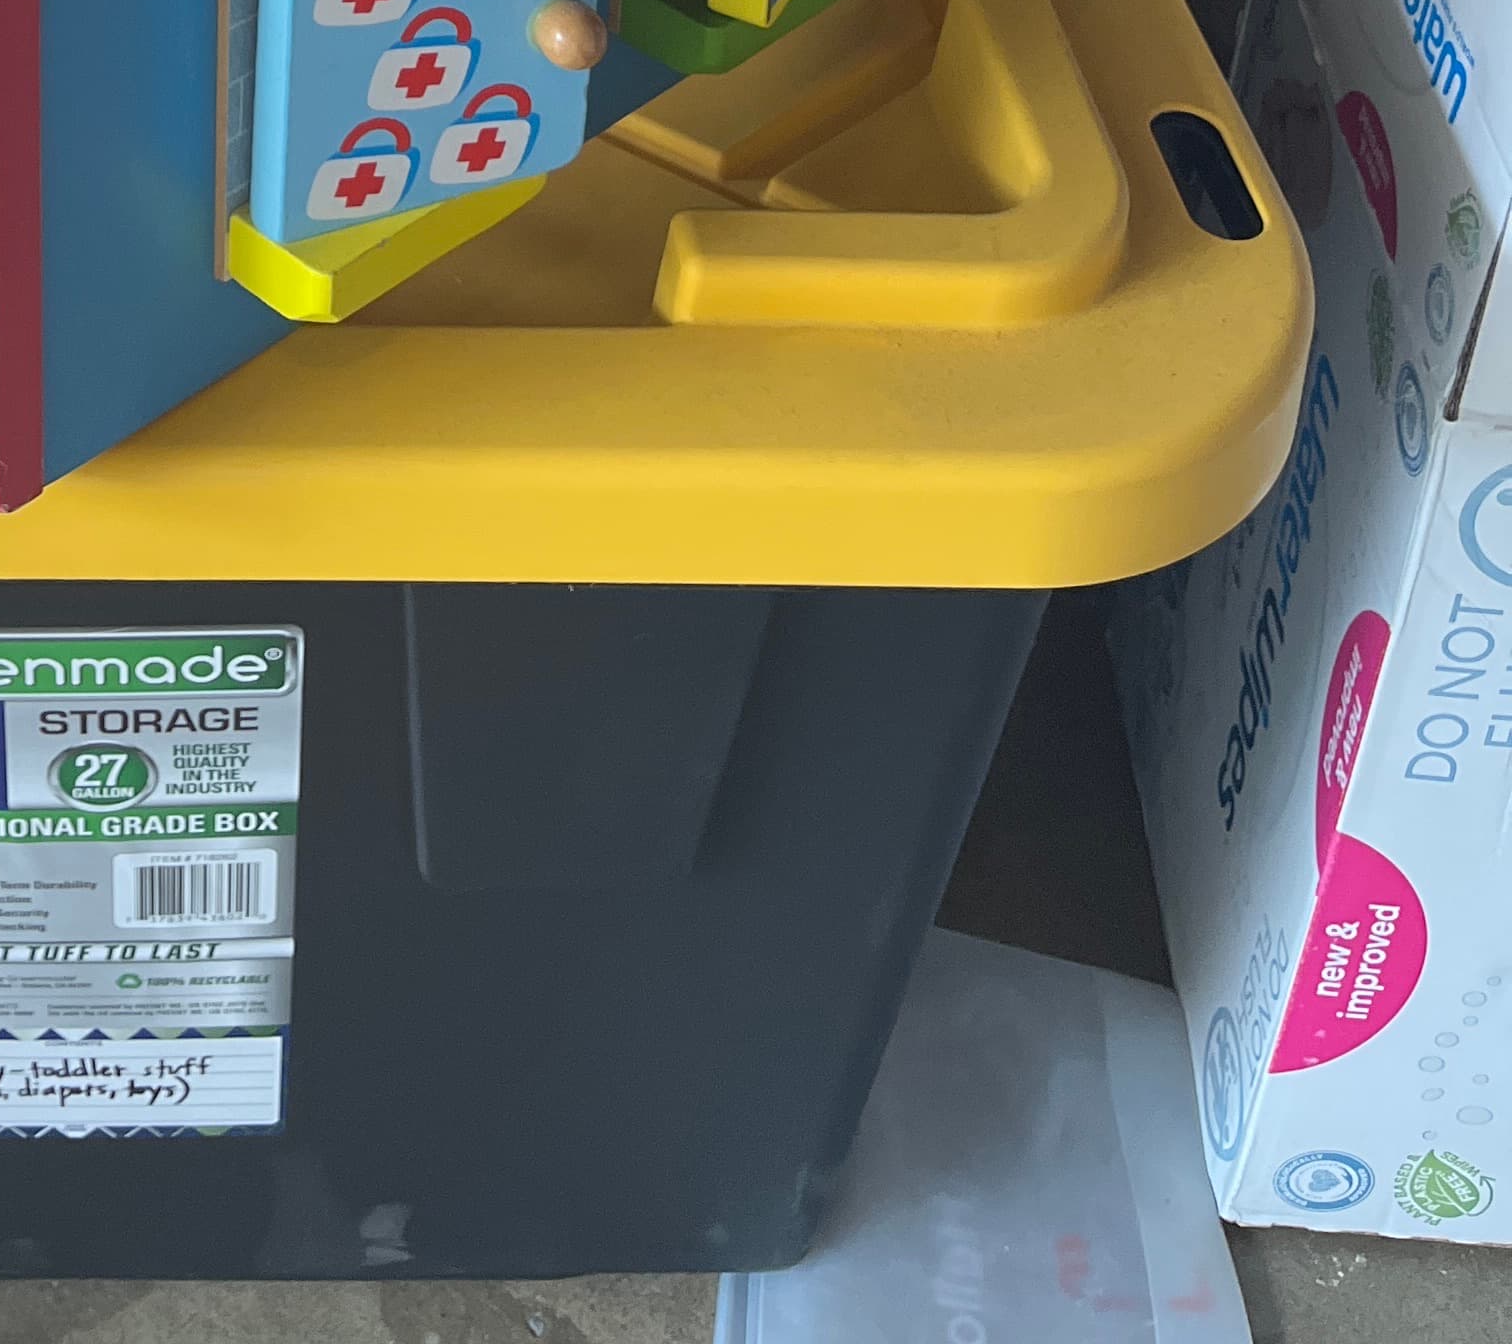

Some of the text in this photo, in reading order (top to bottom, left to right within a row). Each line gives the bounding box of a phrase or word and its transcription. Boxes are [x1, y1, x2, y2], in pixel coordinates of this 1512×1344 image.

[1405, 592, 1505, 783] DO NOT
[38, 706, 260, 736] STORAGE
[1322, 643, 1363, 788] improved
[172, 742, 251, 757] HIGHEST
[1336, 694, 1364, 790] new &
[74, 753, 129, 788] 27
[173, 755, 250, 770] QUALITY
[182, 768, 241, 783] IN THE
[71, 787, 136, 799] GALLON
[165, 781, 257, 796] INDUSTRY
[101, 814, 207, 837] GRADE
[214, 811, 279, 832] BOX
[33, 880, 97, 890] Durability
[26, 944, 93, 962] TUFF
[105, 944, 137, 961] TO
[151, 942, 222, 960] LAST
[1316, 920, 1361, 997] new &
[1335, 903, 1401, 1020] improved
[146, 973, 272, 987] 100% RECYCLABLE
[1239, 913, 1272, 1028] FLUSH
[1249, 927, 1290, 1088] DO NOT
[143, 1055, 214, 1079] stuff
[1440, 1150, 1480, 1178] WIPES
[1394, 1163, 1414, 1199] BASED
[1412, 1166, 1441, 1212] PLASTIC
[1397, 1198, 1443, 1226] PLANT
